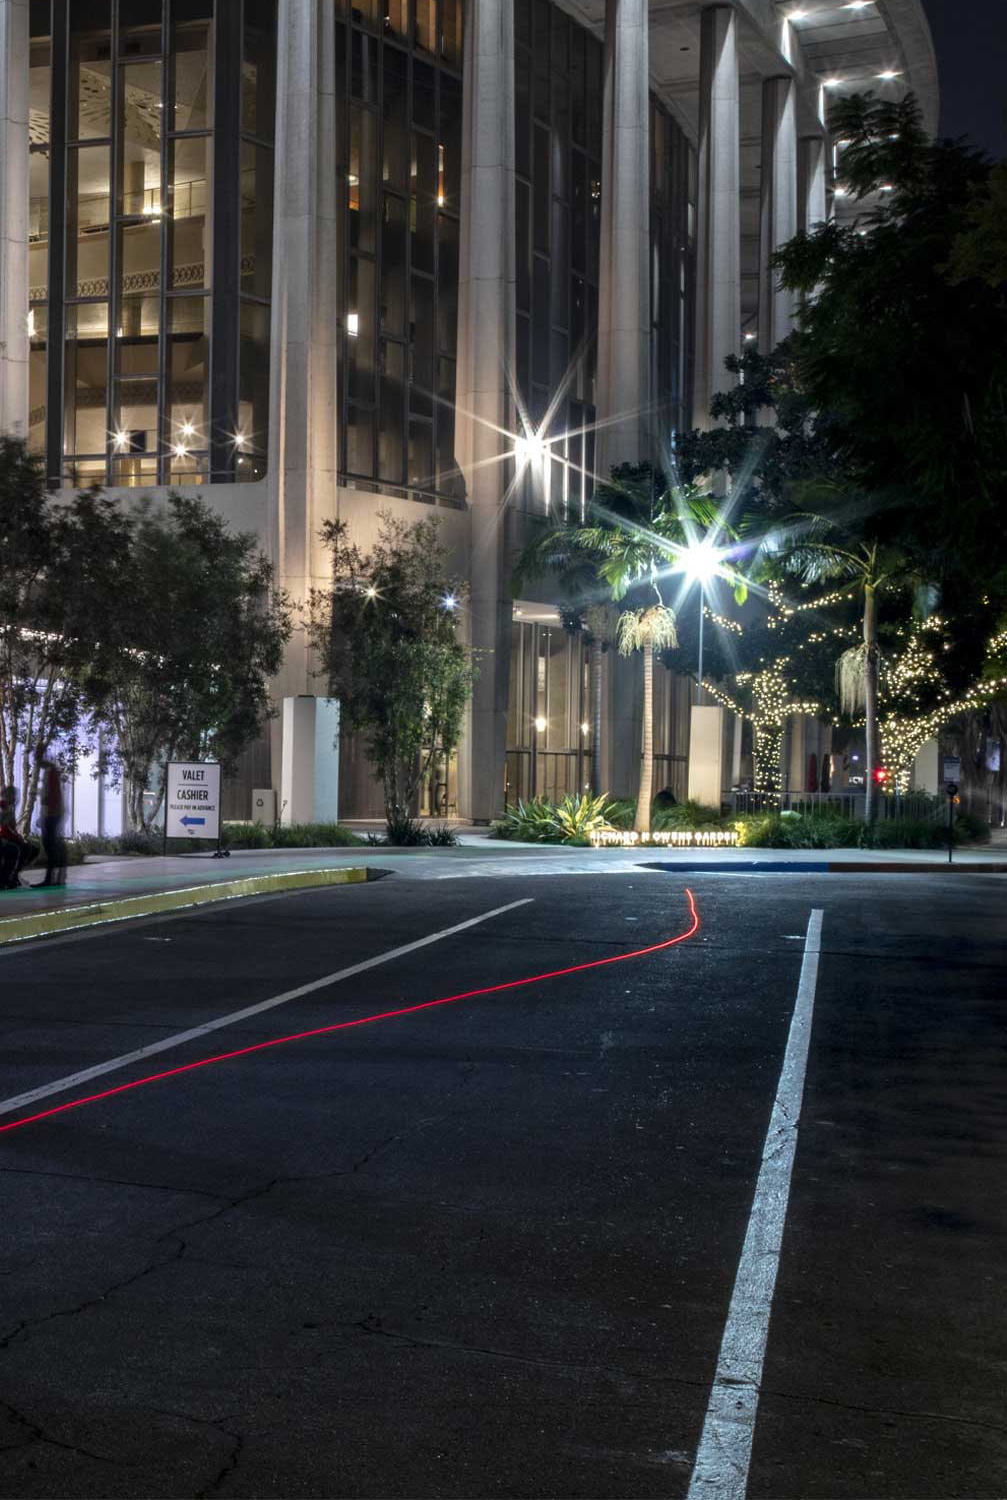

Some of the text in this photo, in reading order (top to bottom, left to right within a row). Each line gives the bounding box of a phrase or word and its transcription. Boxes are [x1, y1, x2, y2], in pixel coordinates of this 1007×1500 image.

[182, 770, 205, 781] VALET
[177, 789, 209, 801] CASHIER
[652, 831, 692, 842] OWENS
[694, 831, 738, 842] GARDEN
